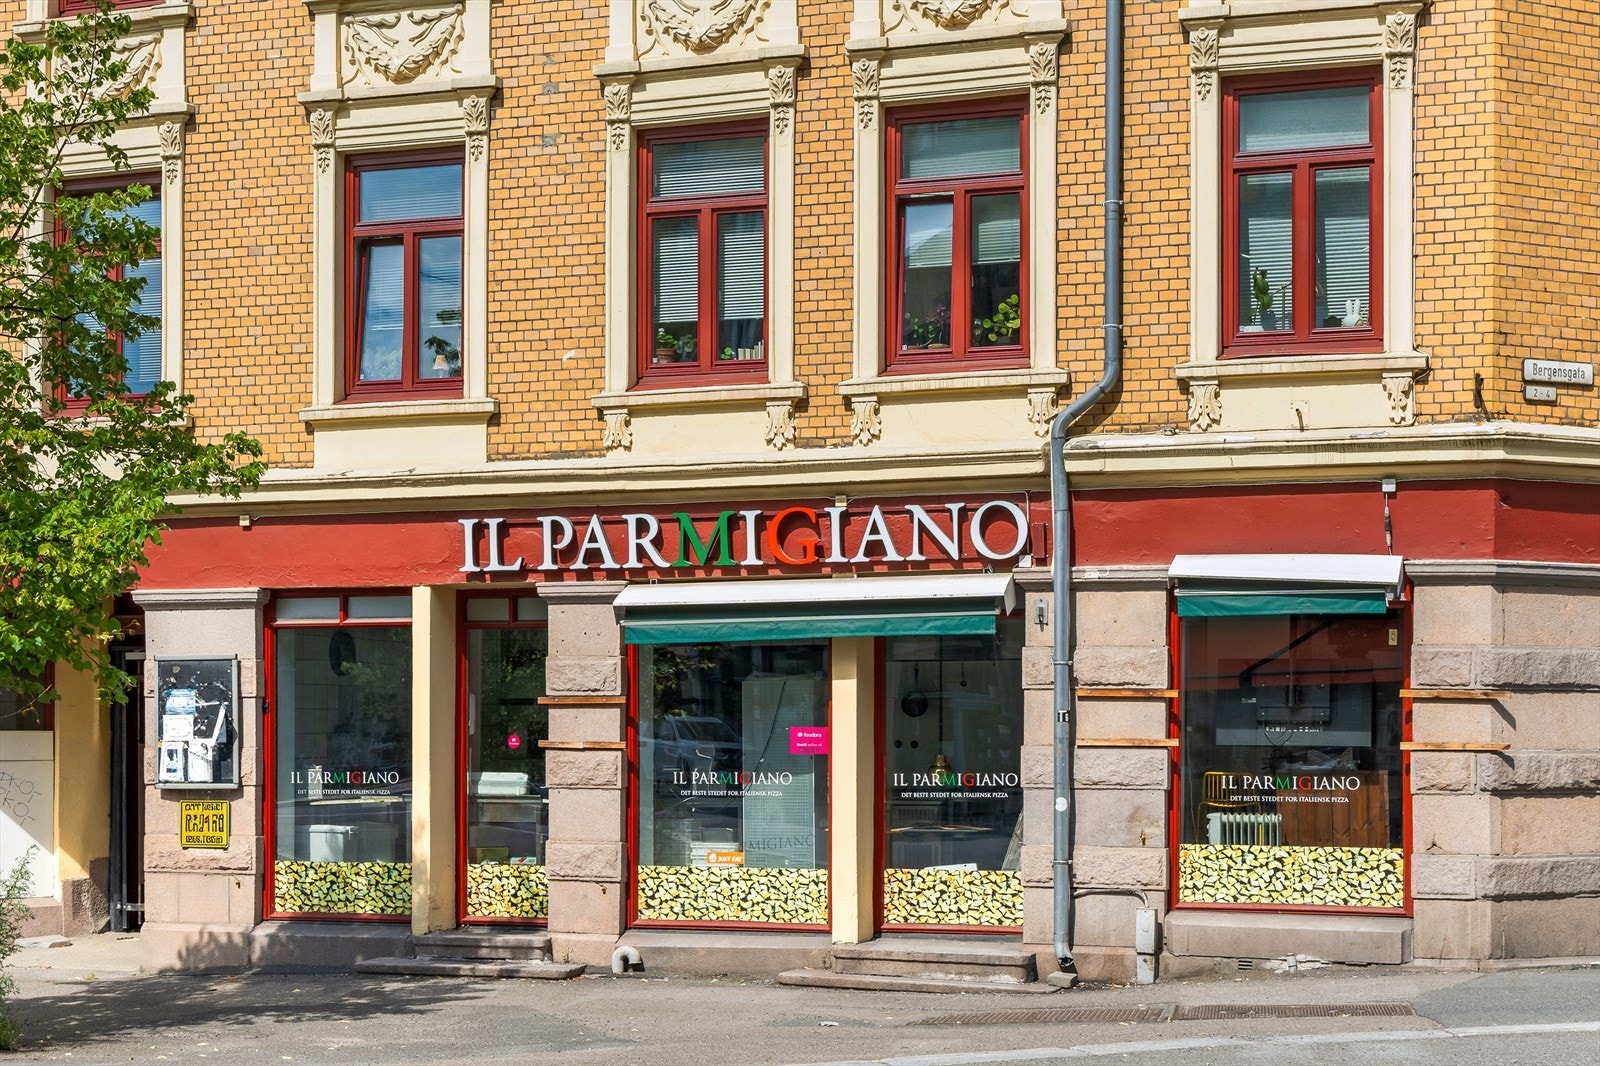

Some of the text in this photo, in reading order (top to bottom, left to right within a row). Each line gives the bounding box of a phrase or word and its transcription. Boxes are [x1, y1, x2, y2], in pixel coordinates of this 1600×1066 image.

[1532, 362, 1586, 382] Bergensgata
[457, 500, 1029, 573] IL PARMIGIANO
[291, 771, 399, 784] IL PARMIGIANO
[673, 771, 793, 785] IL PARMIGIANO
[893, 772, 1018, 787] IL PARMIGIANO
[1221, 775, 1360, 790] IL PARMIGIANO
[1230, 795, 1349, 803] DET BESTE STEDET FOR ITALIENSK PIZZA
